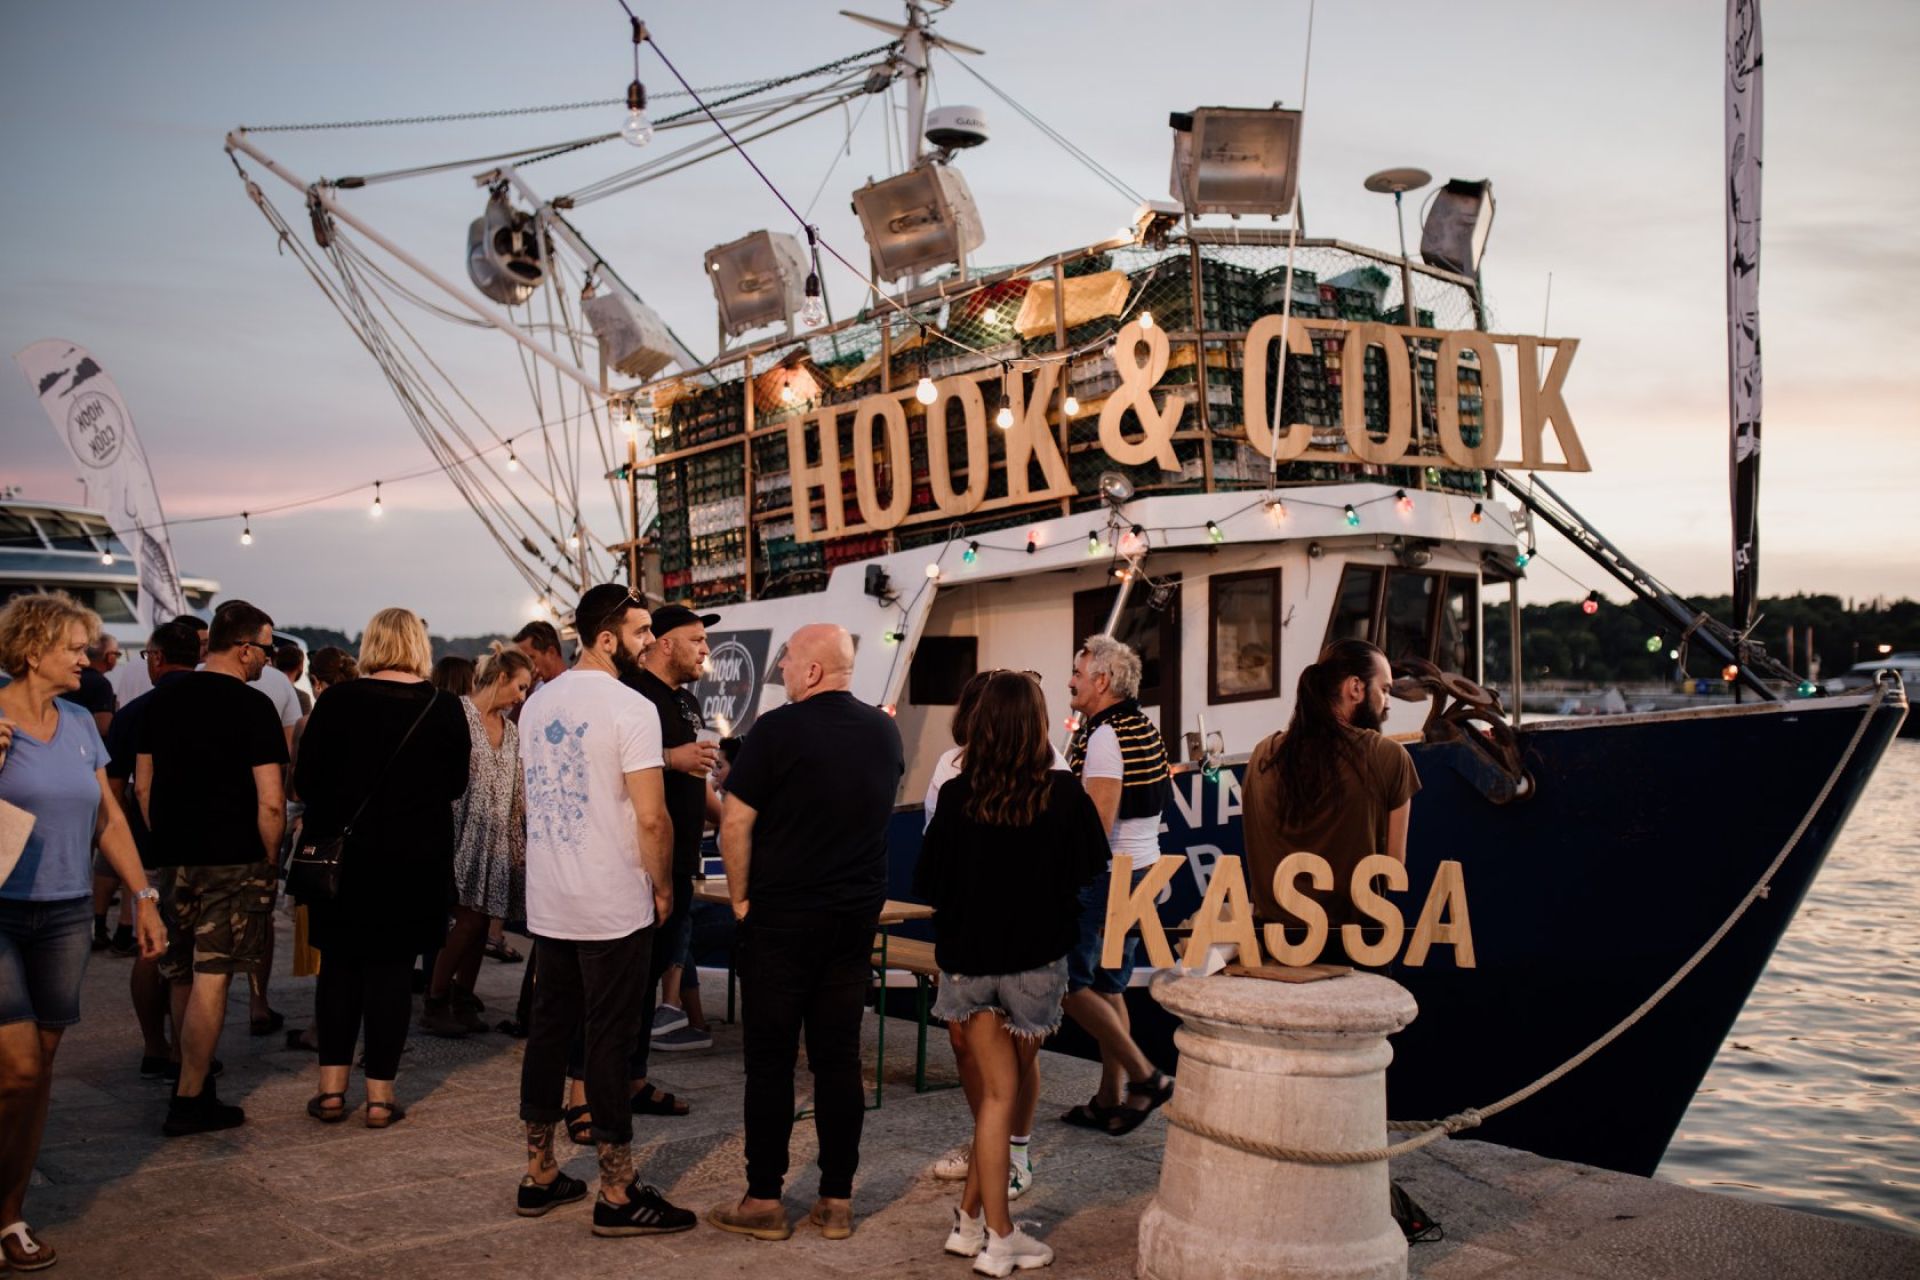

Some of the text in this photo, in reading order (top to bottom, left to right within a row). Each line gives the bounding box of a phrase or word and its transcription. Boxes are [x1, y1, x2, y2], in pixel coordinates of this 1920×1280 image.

[787, 315, 1592, 543] HOOK & COOK
[709, 658, 743, 682] HOOK
[718, 681, 727, 695] &
[703, 695, 736, 719] COOK
[1101, 852, 1477, 969] KASSA
